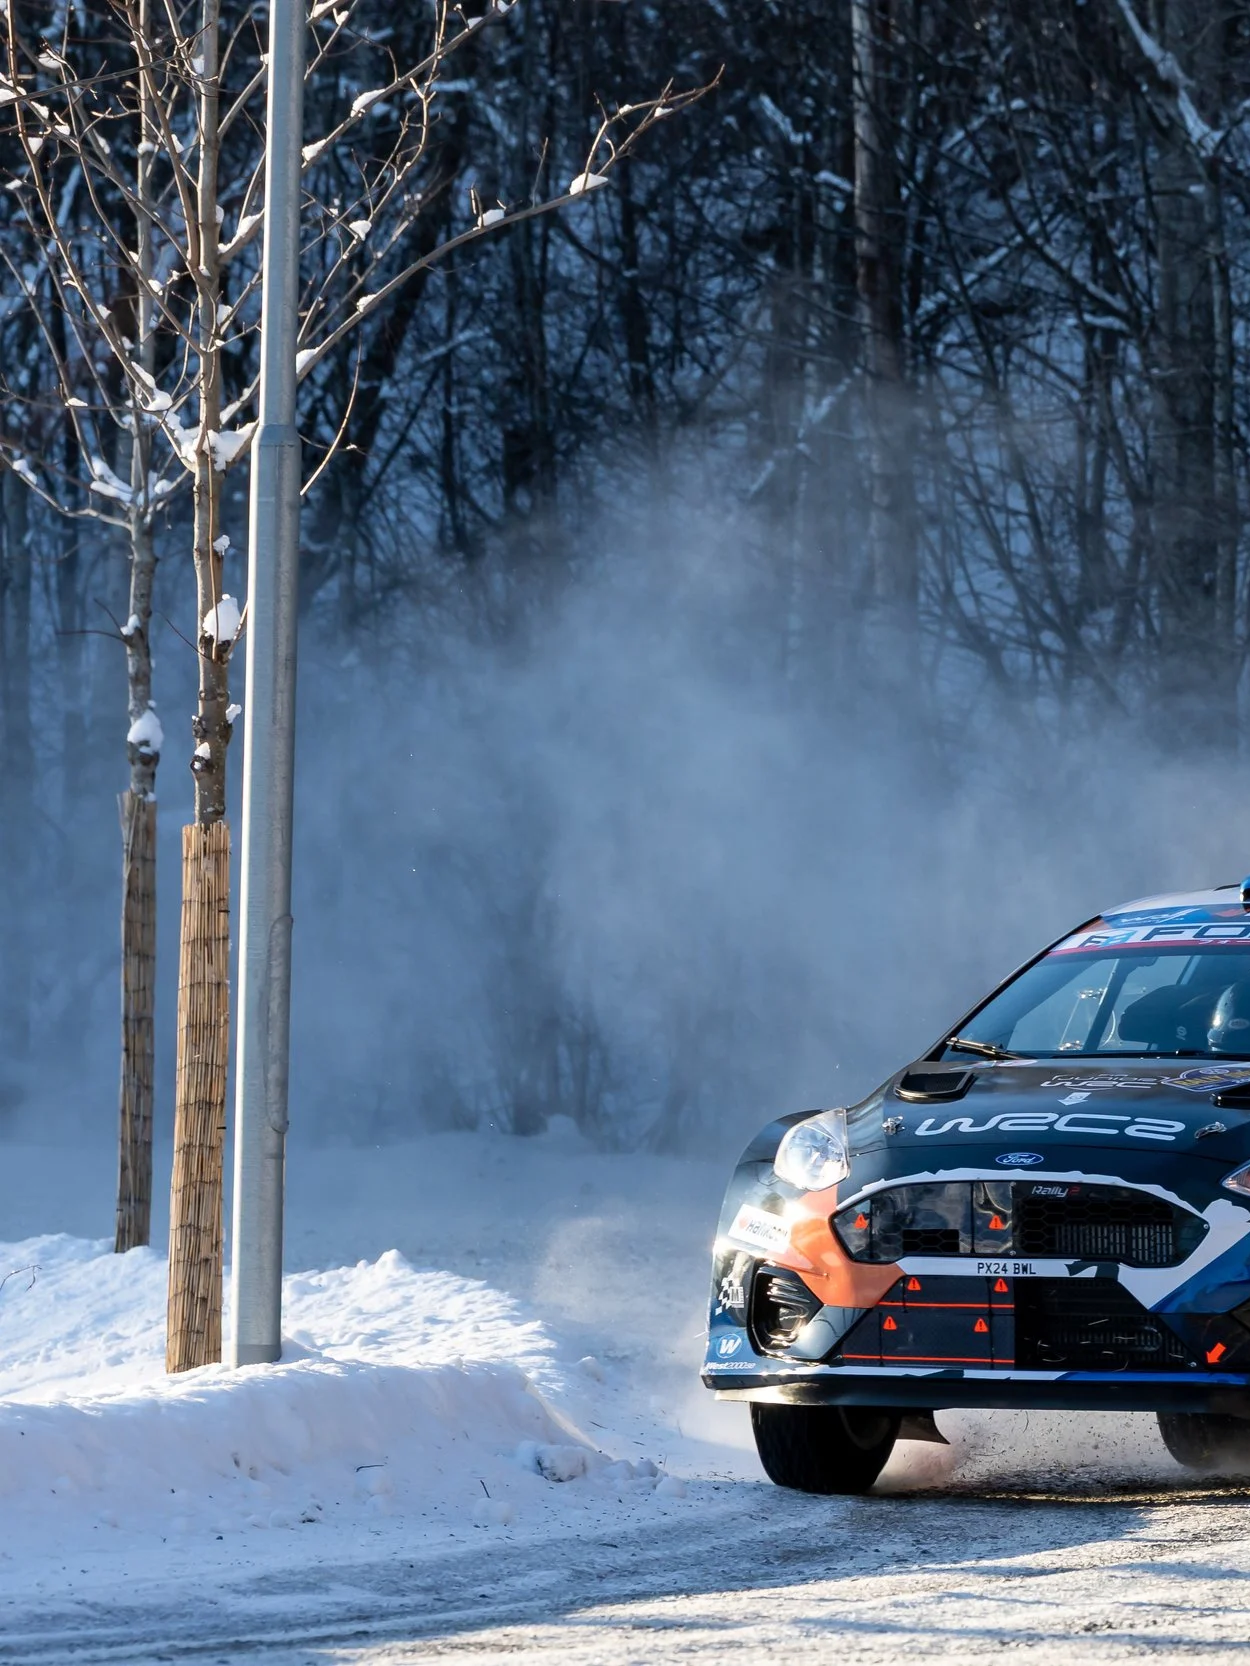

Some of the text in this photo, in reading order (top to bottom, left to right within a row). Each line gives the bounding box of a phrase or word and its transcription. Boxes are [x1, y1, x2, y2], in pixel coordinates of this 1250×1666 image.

[914, 1112, 1187, 1141] WRC2
[1002, 1154, 1037, 1164] Ford
[977, 1262, 1037, 1275] PX24 BWL
[719, 1337, 742, 1354] W
